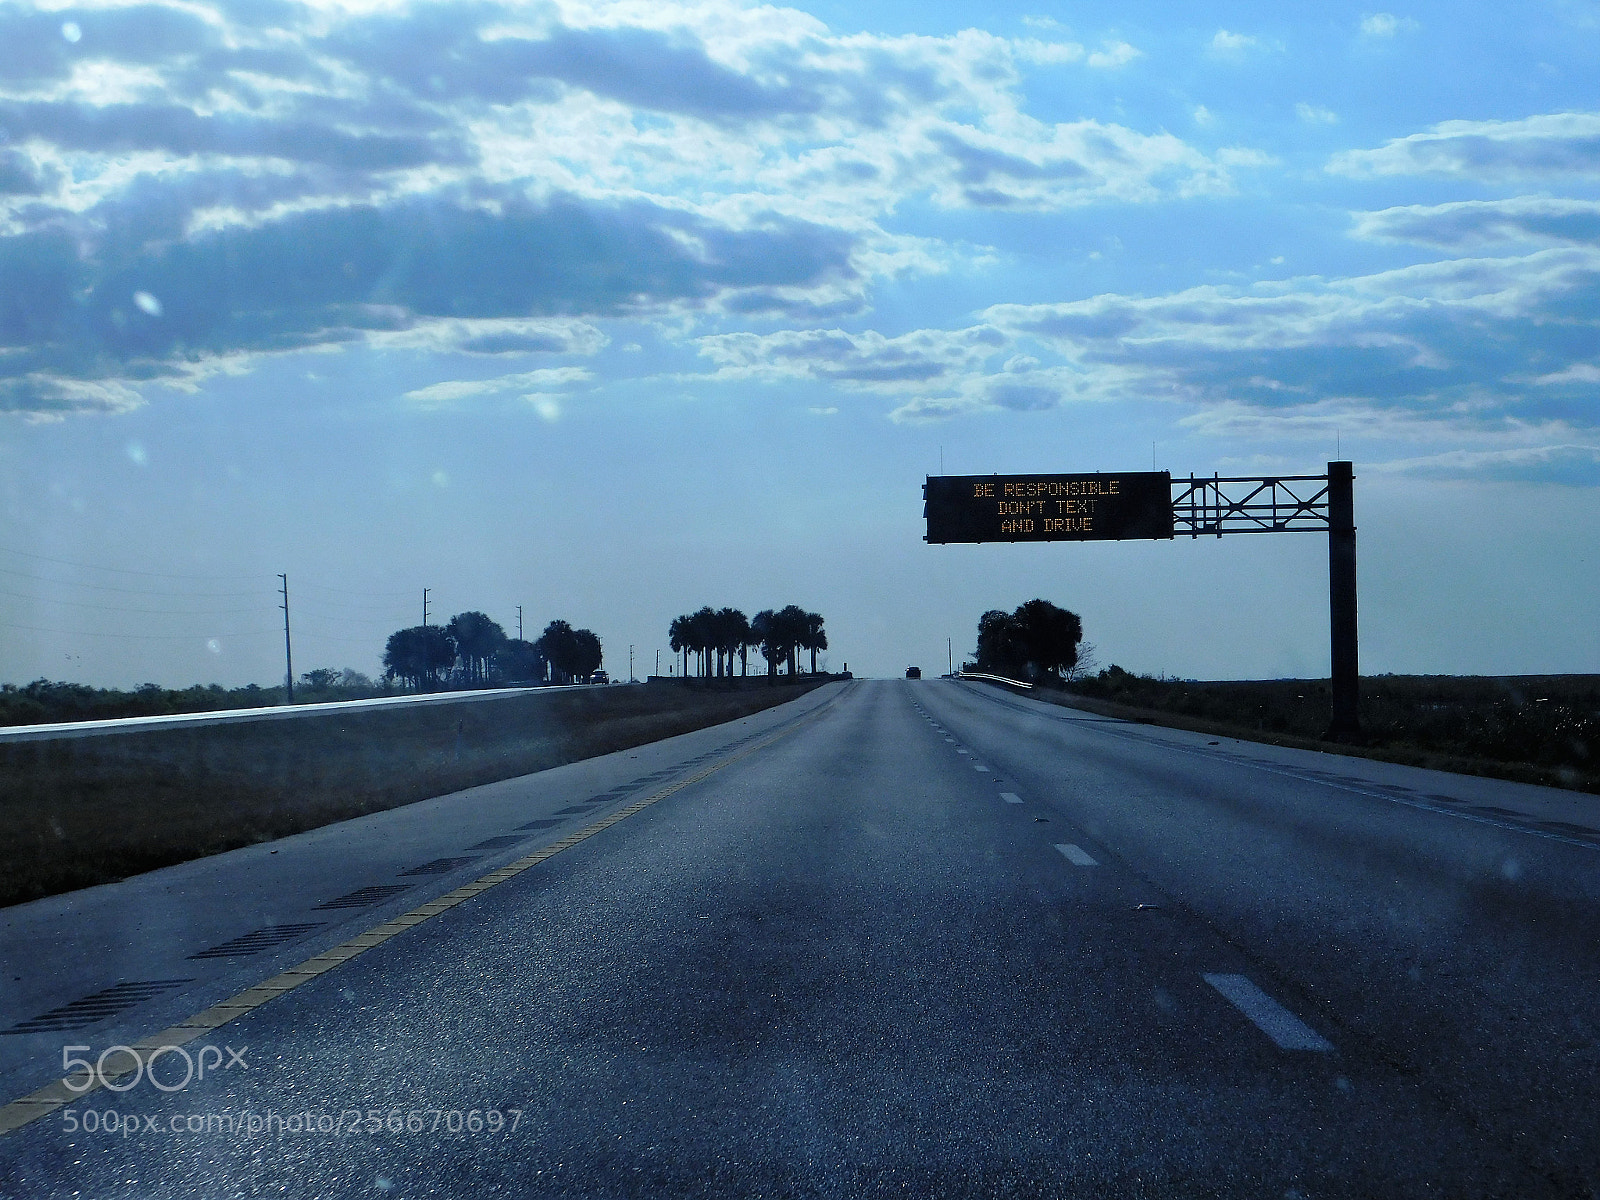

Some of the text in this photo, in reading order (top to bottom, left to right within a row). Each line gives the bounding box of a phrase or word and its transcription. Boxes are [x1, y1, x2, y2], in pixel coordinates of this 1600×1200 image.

[973, 480, 1120, 497] BE RESPONSIBLE
[997, 499, 1098, 515] DON'T TEXT
[1001, 517, 1093, 533] AND DRIVE
